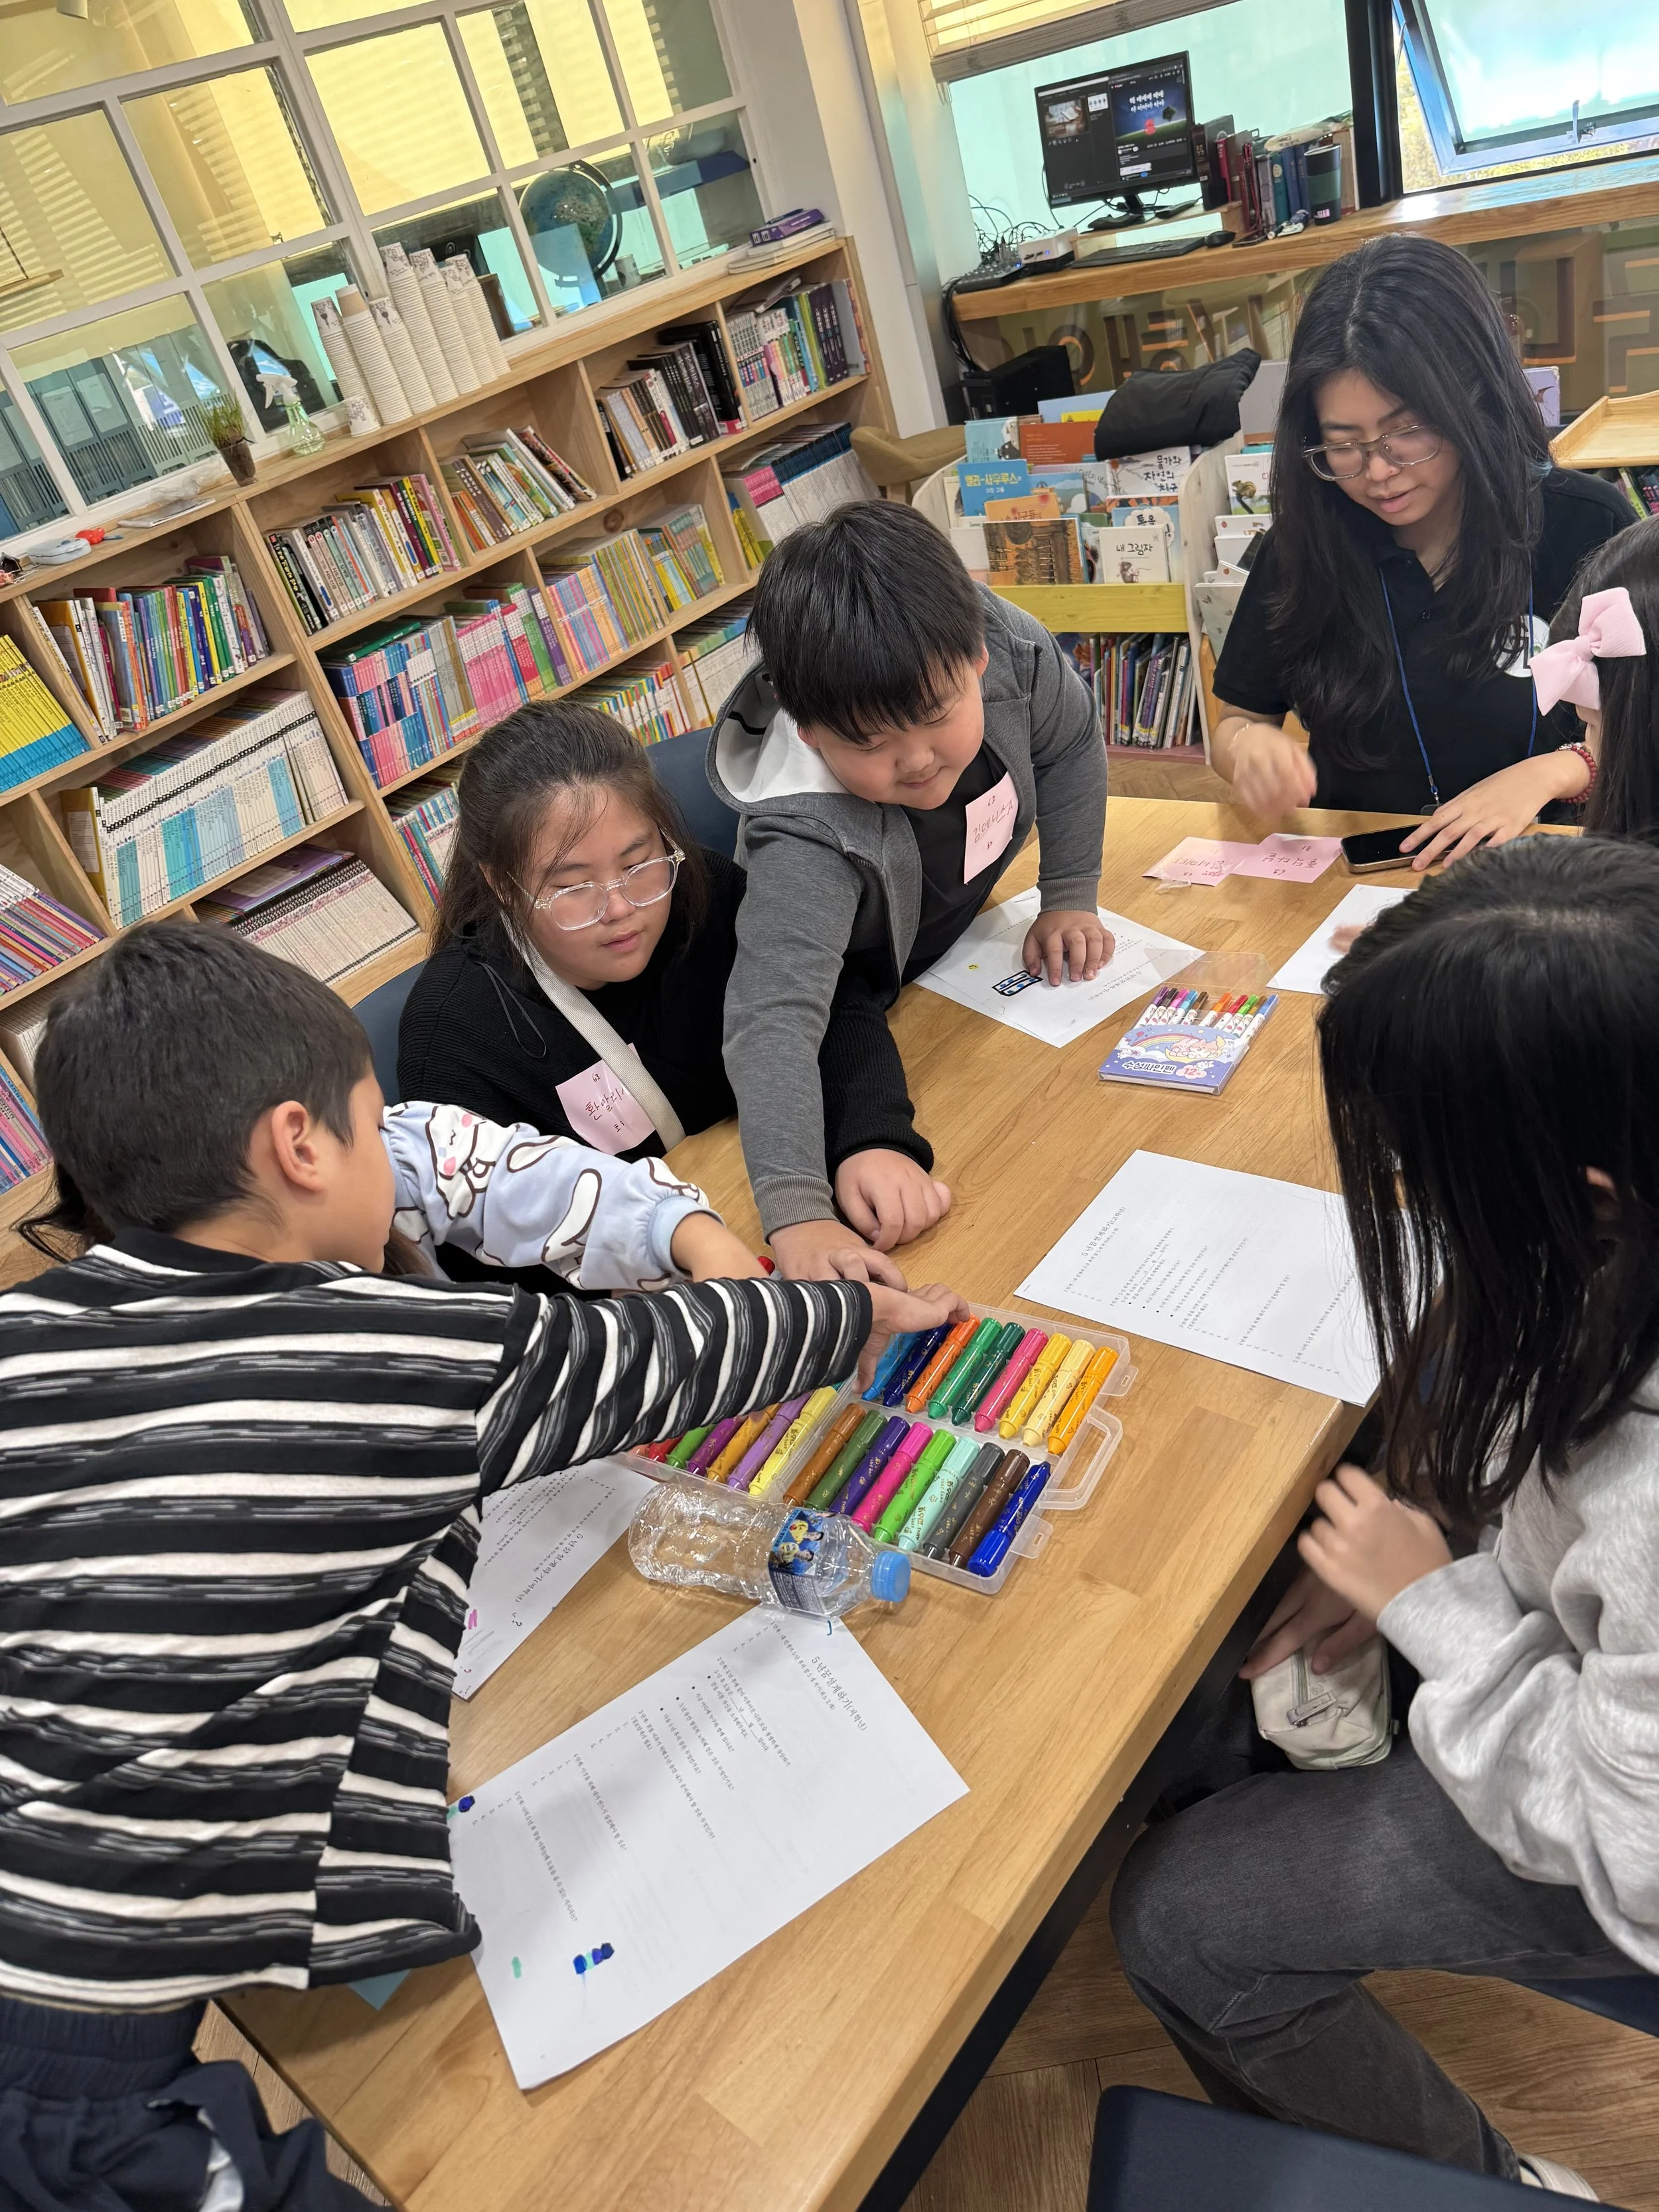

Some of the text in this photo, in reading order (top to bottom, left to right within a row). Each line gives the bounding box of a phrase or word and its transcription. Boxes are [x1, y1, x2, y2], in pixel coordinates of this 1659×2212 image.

[1116, 543, 1153, 555] 내 그림자
[1121, 1060, 1177, 1074] 수성싸인펜
